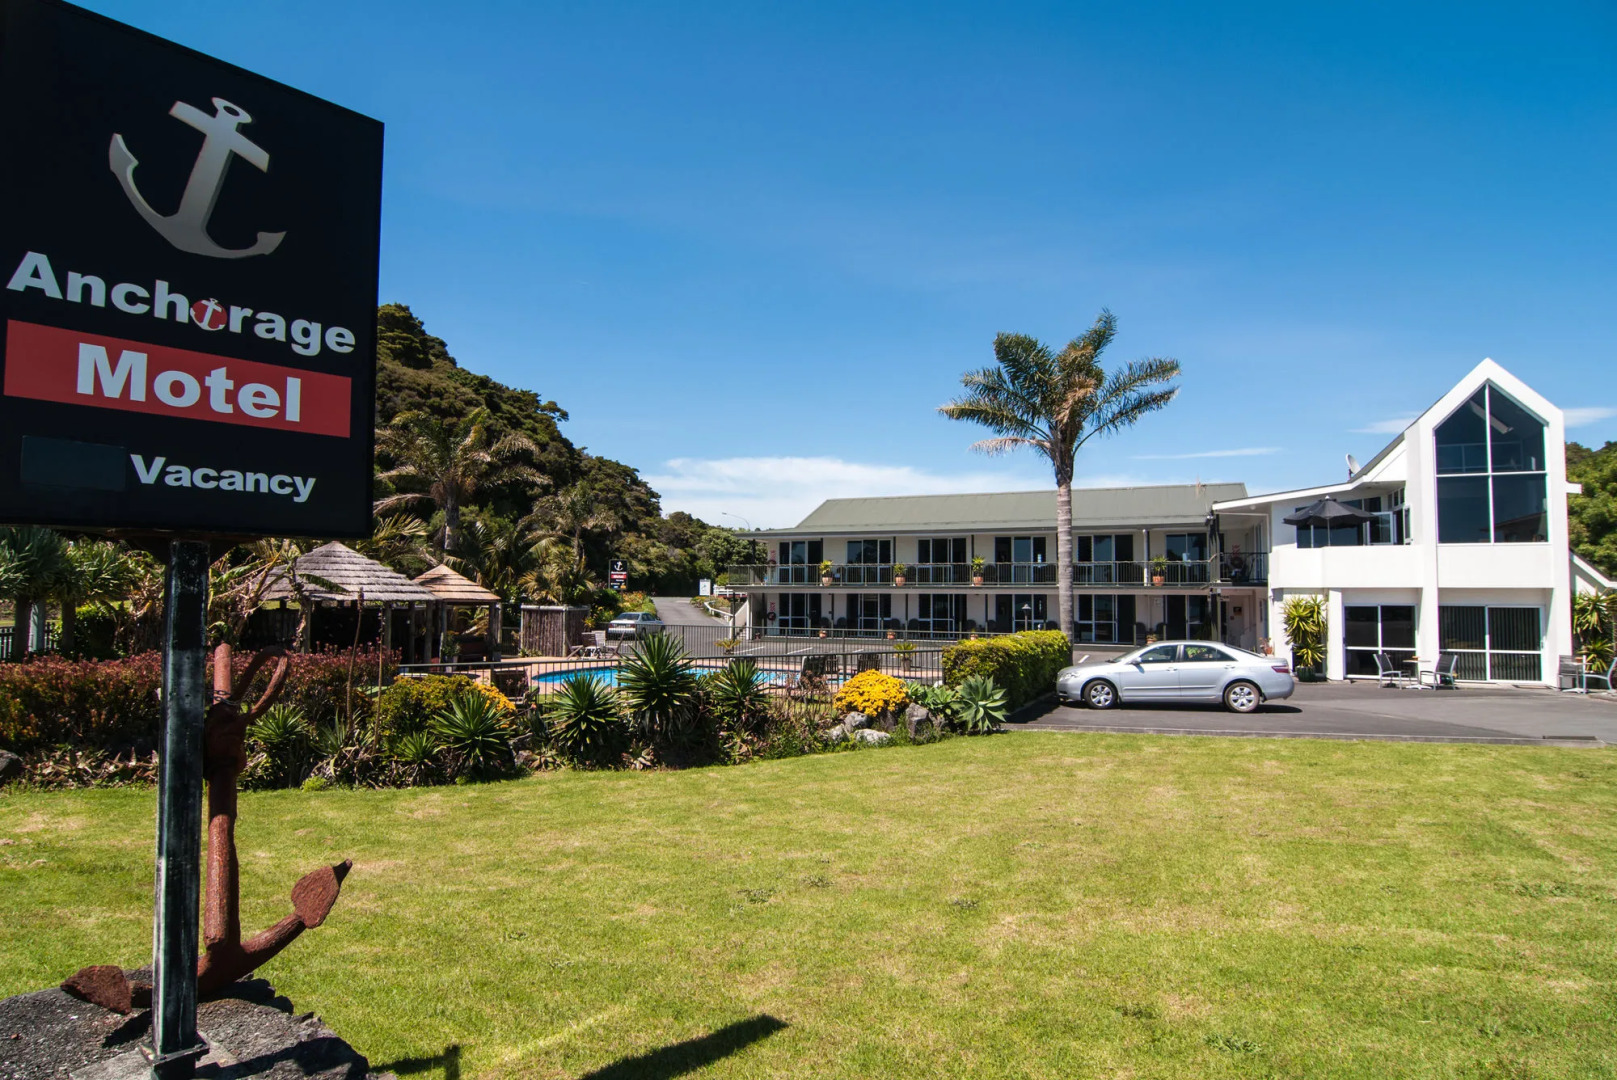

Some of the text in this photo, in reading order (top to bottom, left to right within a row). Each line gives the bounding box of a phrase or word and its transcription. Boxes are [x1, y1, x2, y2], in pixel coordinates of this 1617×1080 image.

[7, 251, 356, 356] Anchorage
[76, 342, 301, 423] Motel
[130, 454, 316, 502] Vacancy
